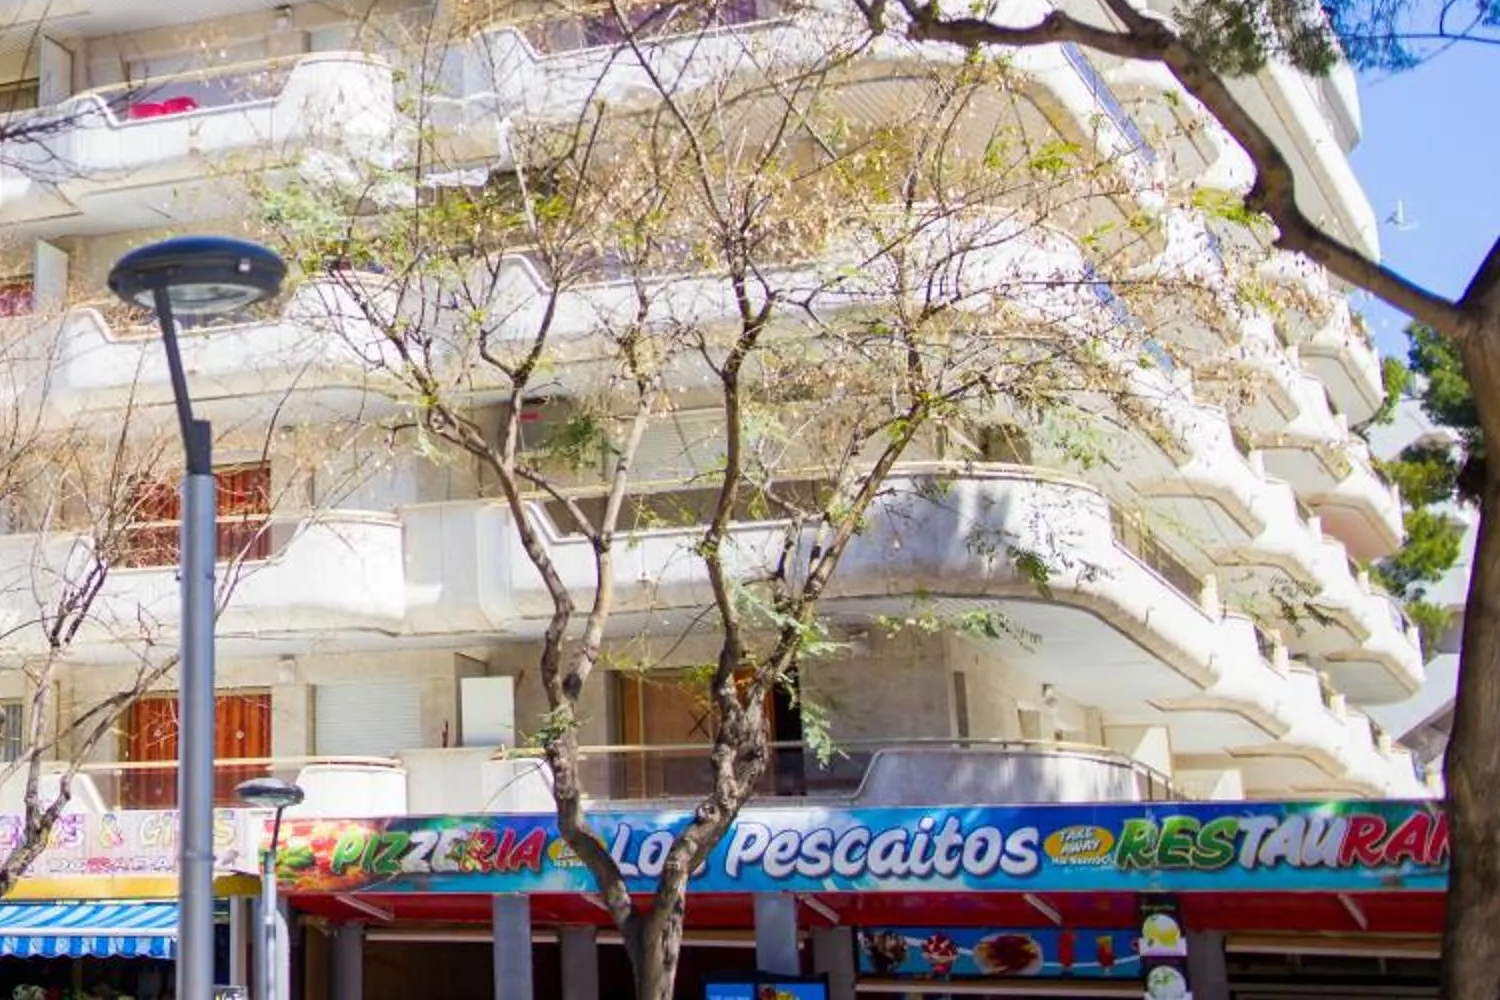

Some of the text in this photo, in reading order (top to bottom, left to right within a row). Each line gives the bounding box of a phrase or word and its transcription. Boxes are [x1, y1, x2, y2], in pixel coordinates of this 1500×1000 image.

[331, 825, 545, 875] PIZZERIA
[611, 822, 707, 877] Lo
[725, 815, 1040, 878] Pescaitos
